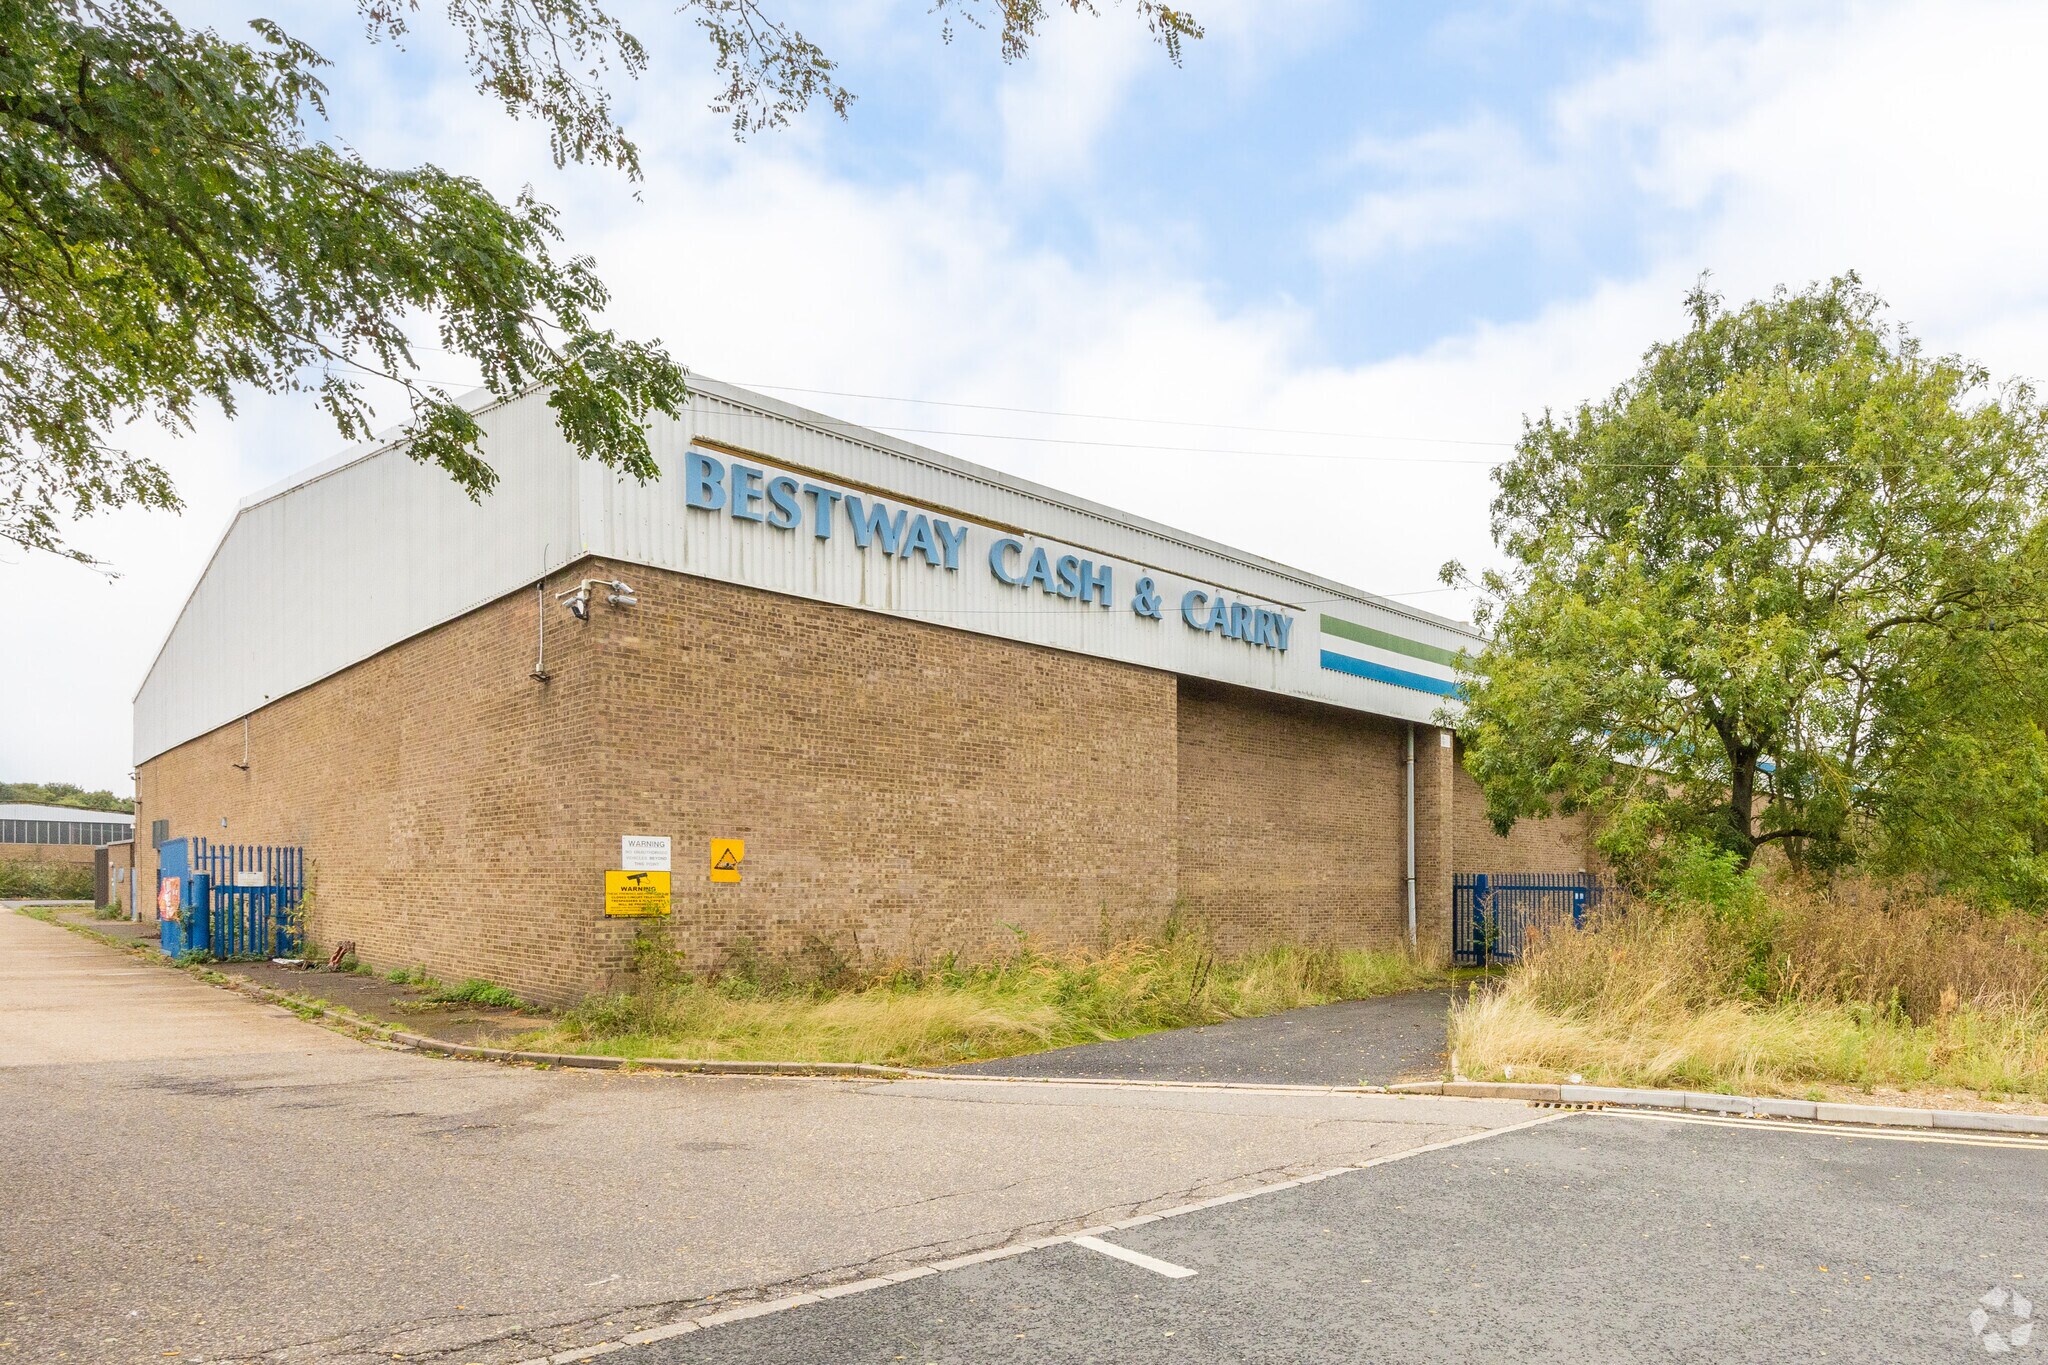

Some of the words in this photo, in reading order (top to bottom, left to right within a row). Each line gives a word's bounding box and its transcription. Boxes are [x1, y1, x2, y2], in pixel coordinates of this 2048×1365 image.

[685, 451, 968, 571] BESTWAY
[988, 538, 1112, 607] CASH
[1132, 576, 1163, 620] &
[1181, 590, 1294, 651] CARRY
[628, 840, 665, 848] WARNING
